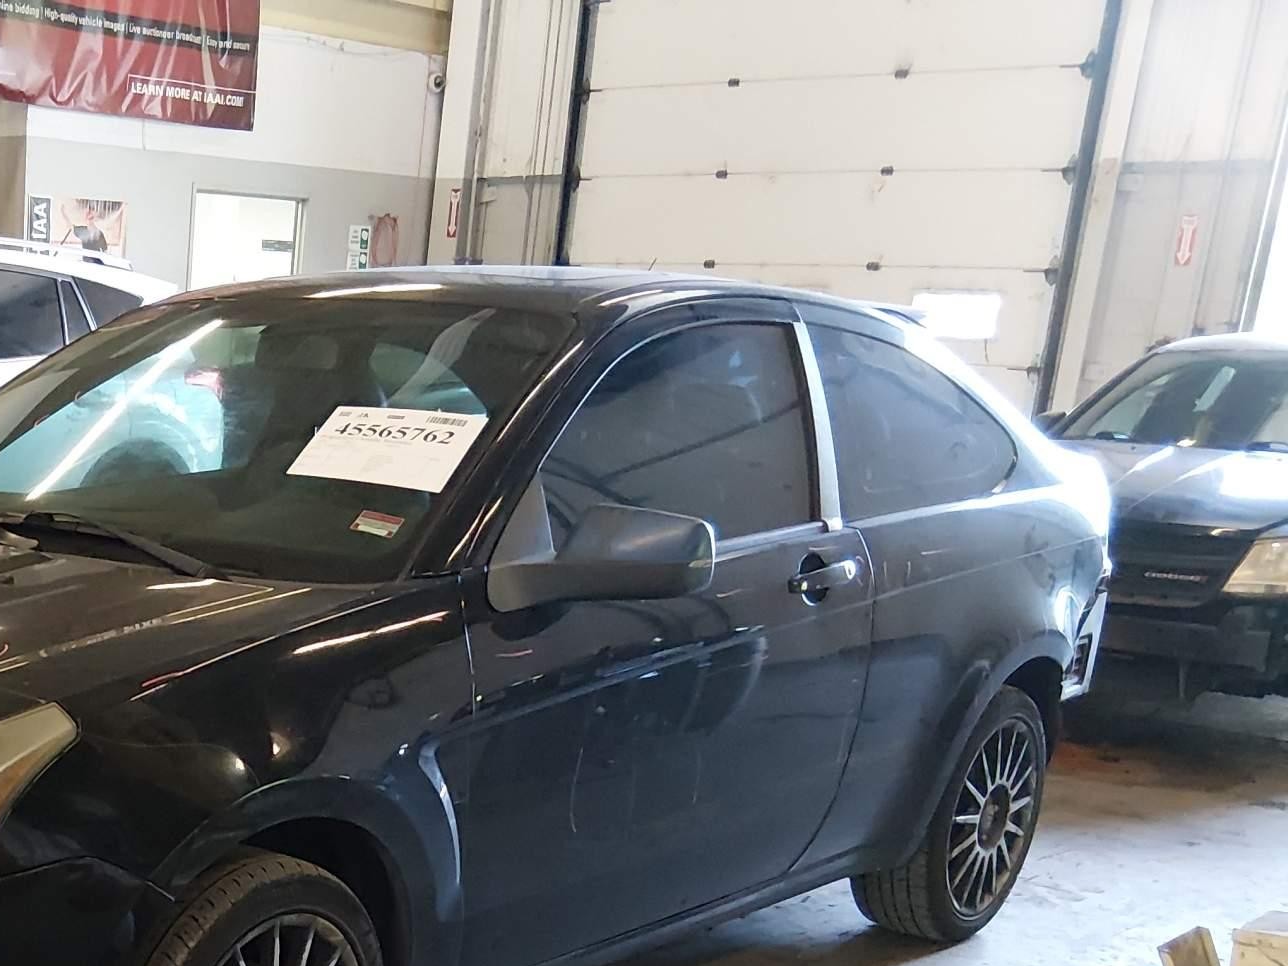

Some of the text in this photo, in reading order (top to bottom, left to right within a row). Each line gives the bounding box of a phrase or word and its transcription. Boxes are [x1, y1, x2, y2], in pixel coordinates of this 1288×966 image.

[15, 2, 40, 18] bidding
[79, 15, 103, 28] vehicle
[129, 23, 141, 34] Live
[131, 82, 244, 107] LEARN MORE AT IAAI.COM
[32, 202, 47, 239] IAA
[335, 422, 456, 445] 45565762
